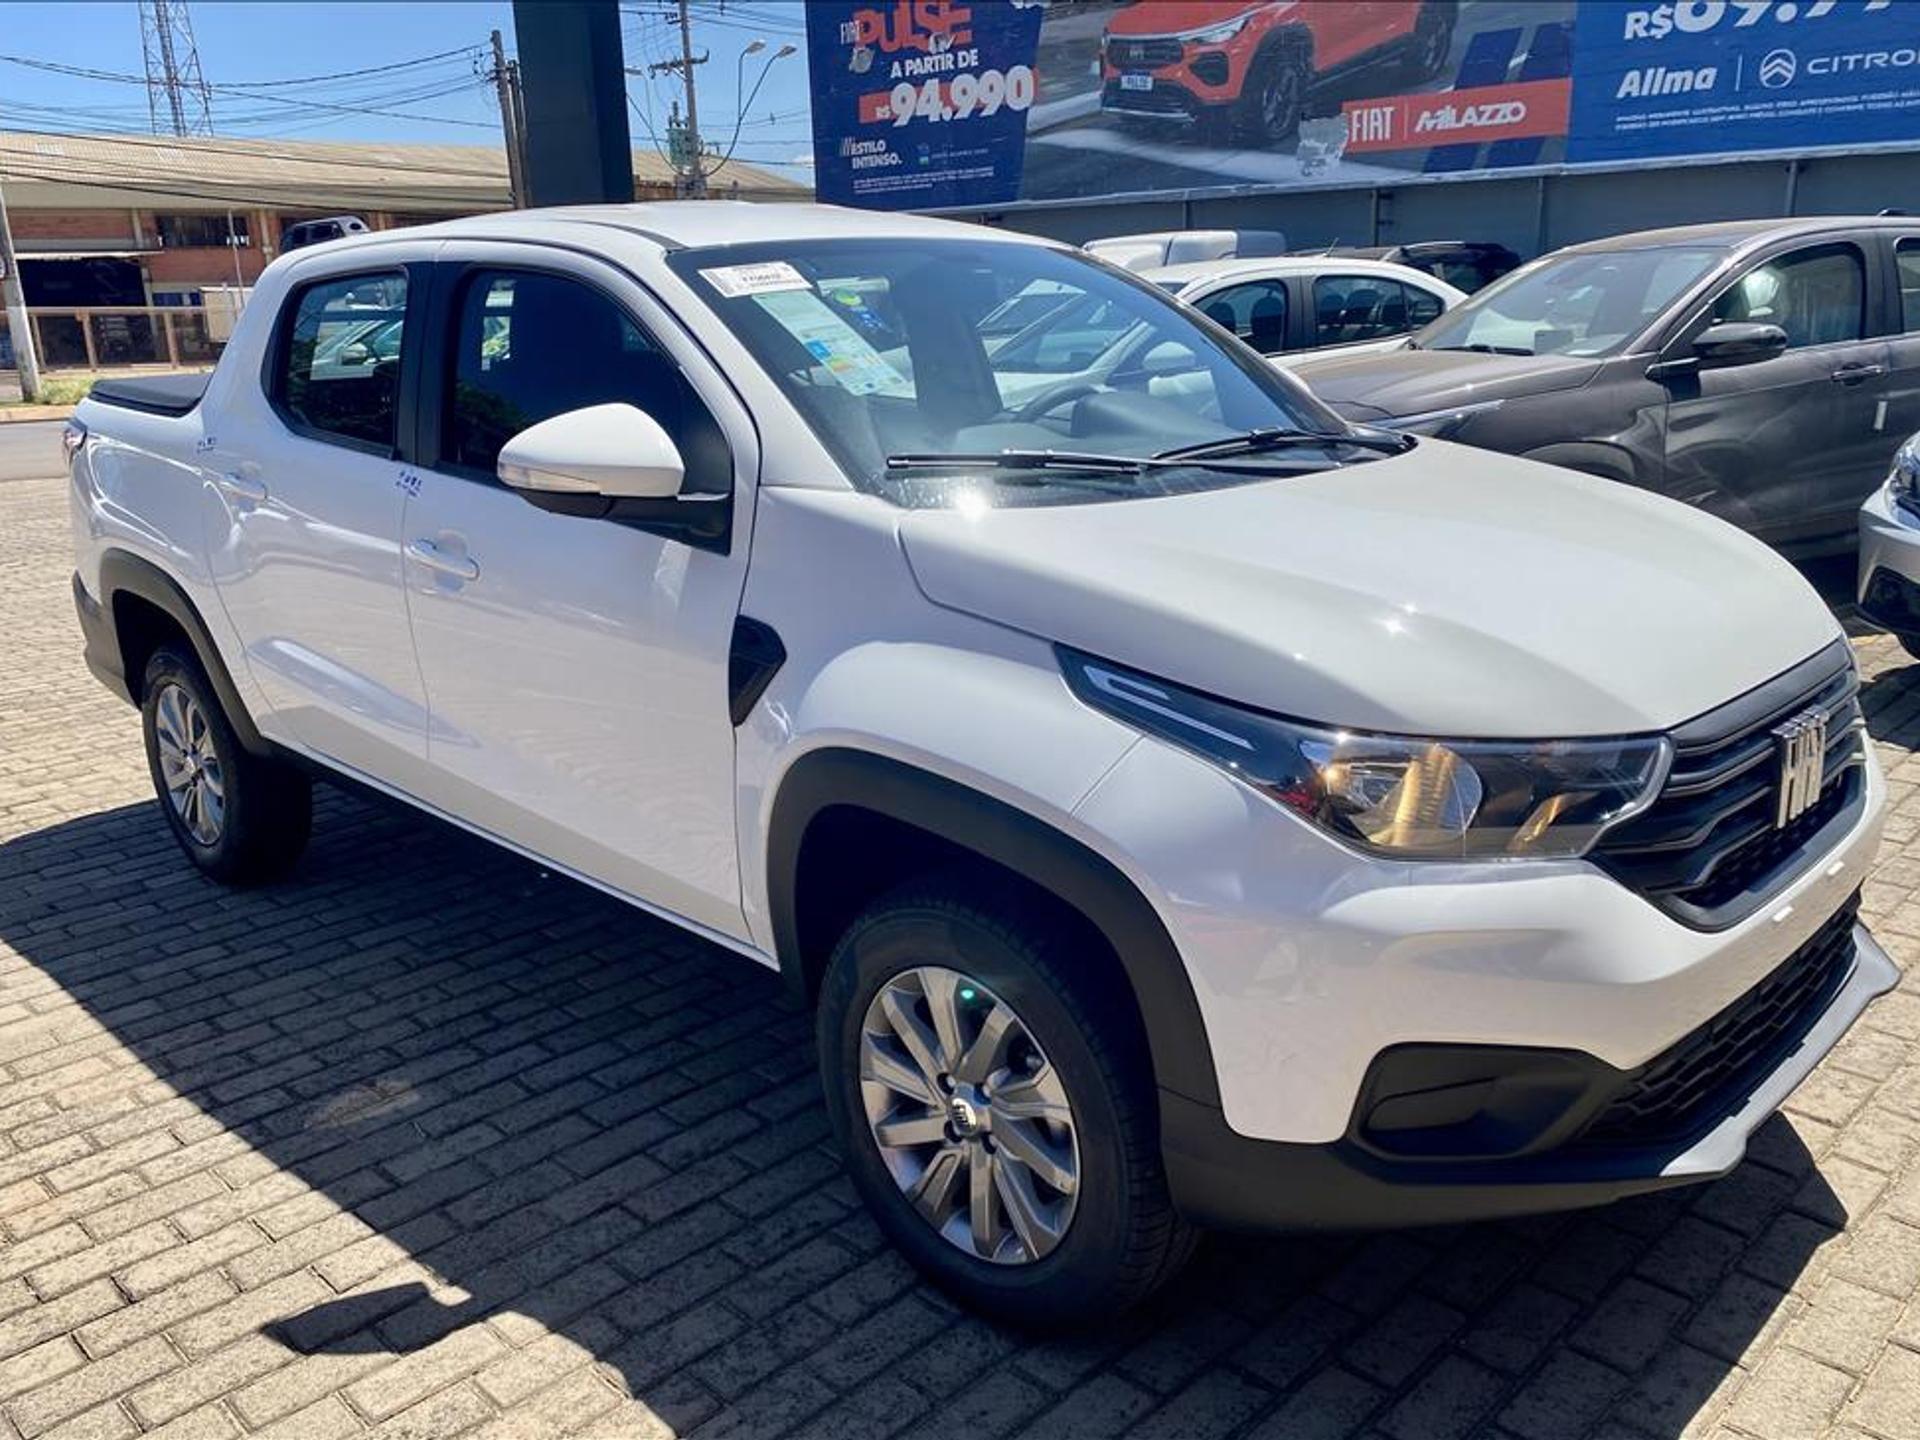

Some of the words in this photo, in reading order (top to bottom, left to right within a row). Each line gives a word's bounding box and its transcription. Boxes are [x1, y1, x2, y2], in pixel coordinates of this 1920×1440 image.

[853, 0, 972, 52] PULSE
[890, 61, 902, 78] A
[905, 54, 954, 76] PARTIR
[957, 49, 979, 67] DE
[1616, 67, 1718, 98] Allma
[1807, 49, 1920, 74] CITRO
[1351, 107, 1395, 142] FIAT
[1414, 101, 1526, 132] MILAZZO
[851, 139, 886, 155] ESTILO
